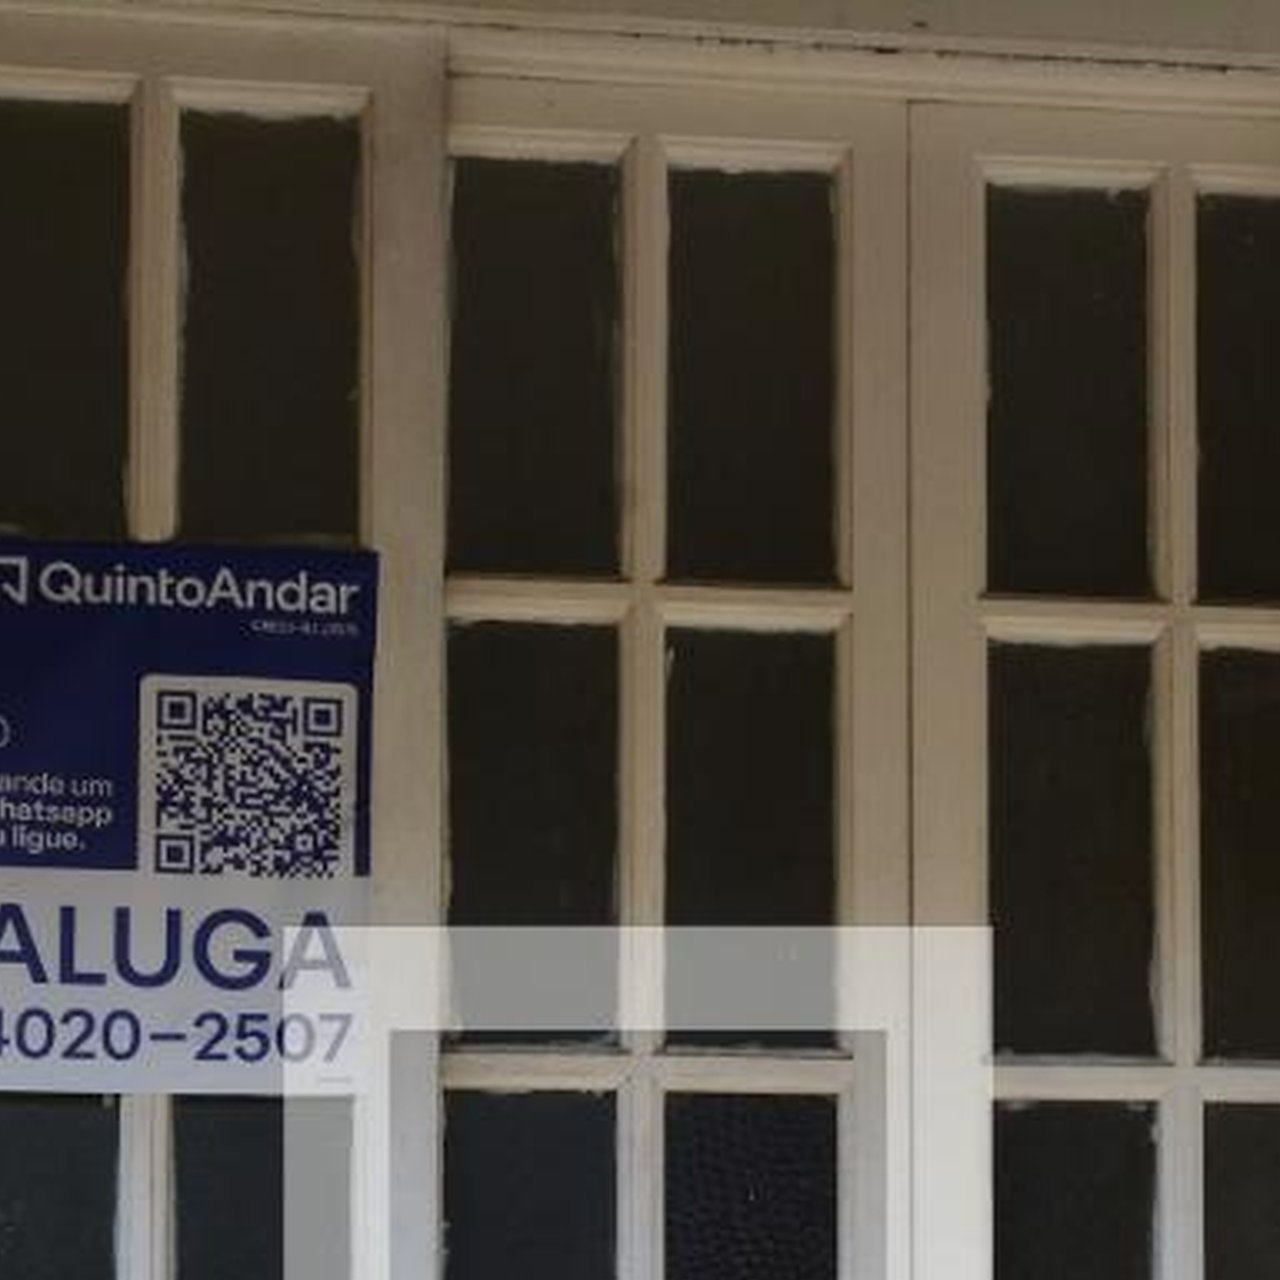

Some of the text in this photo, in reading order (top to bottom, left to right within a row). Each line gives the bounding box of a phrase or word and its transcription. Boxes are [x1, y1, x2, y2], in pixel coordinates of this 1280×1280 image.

[39, 562, 359, 614] QuintoAndar
[70, 779, 112, 797] um
[11, 824, 85, 854] ligue.
